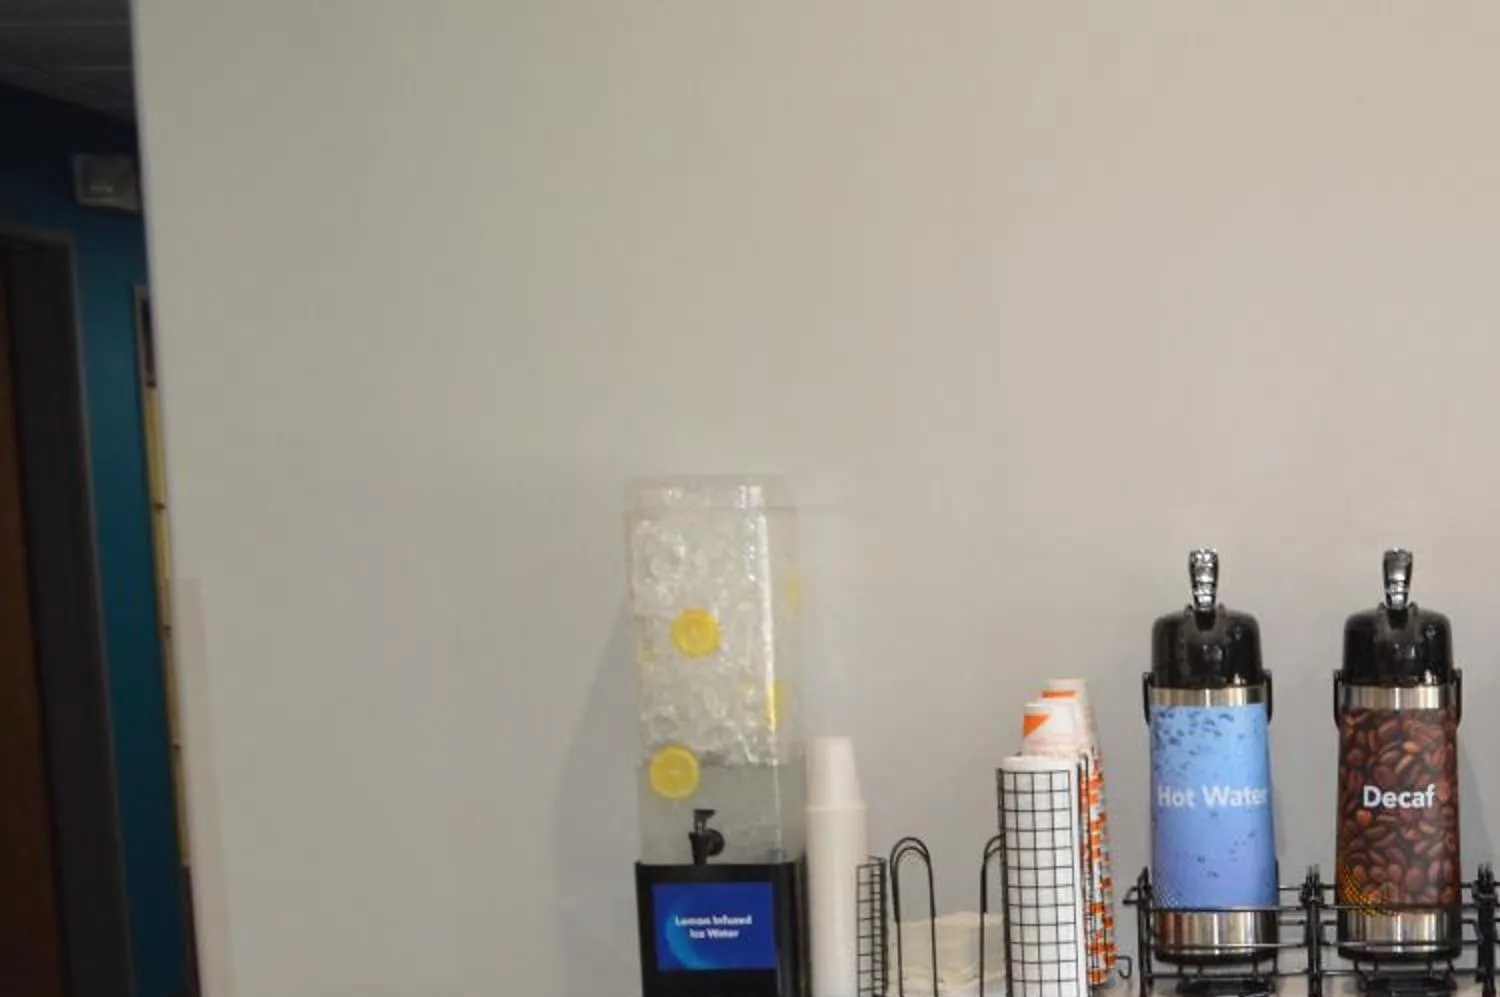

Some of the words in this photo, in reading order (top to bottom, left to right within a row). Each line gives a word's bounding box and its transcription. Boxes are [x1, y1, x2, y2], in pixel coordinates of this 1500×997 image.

[1157, 784, 1196, 808] Hot
[1363, 783, 1435, 809] Decaf
[706, 928, 740, 939] Water
